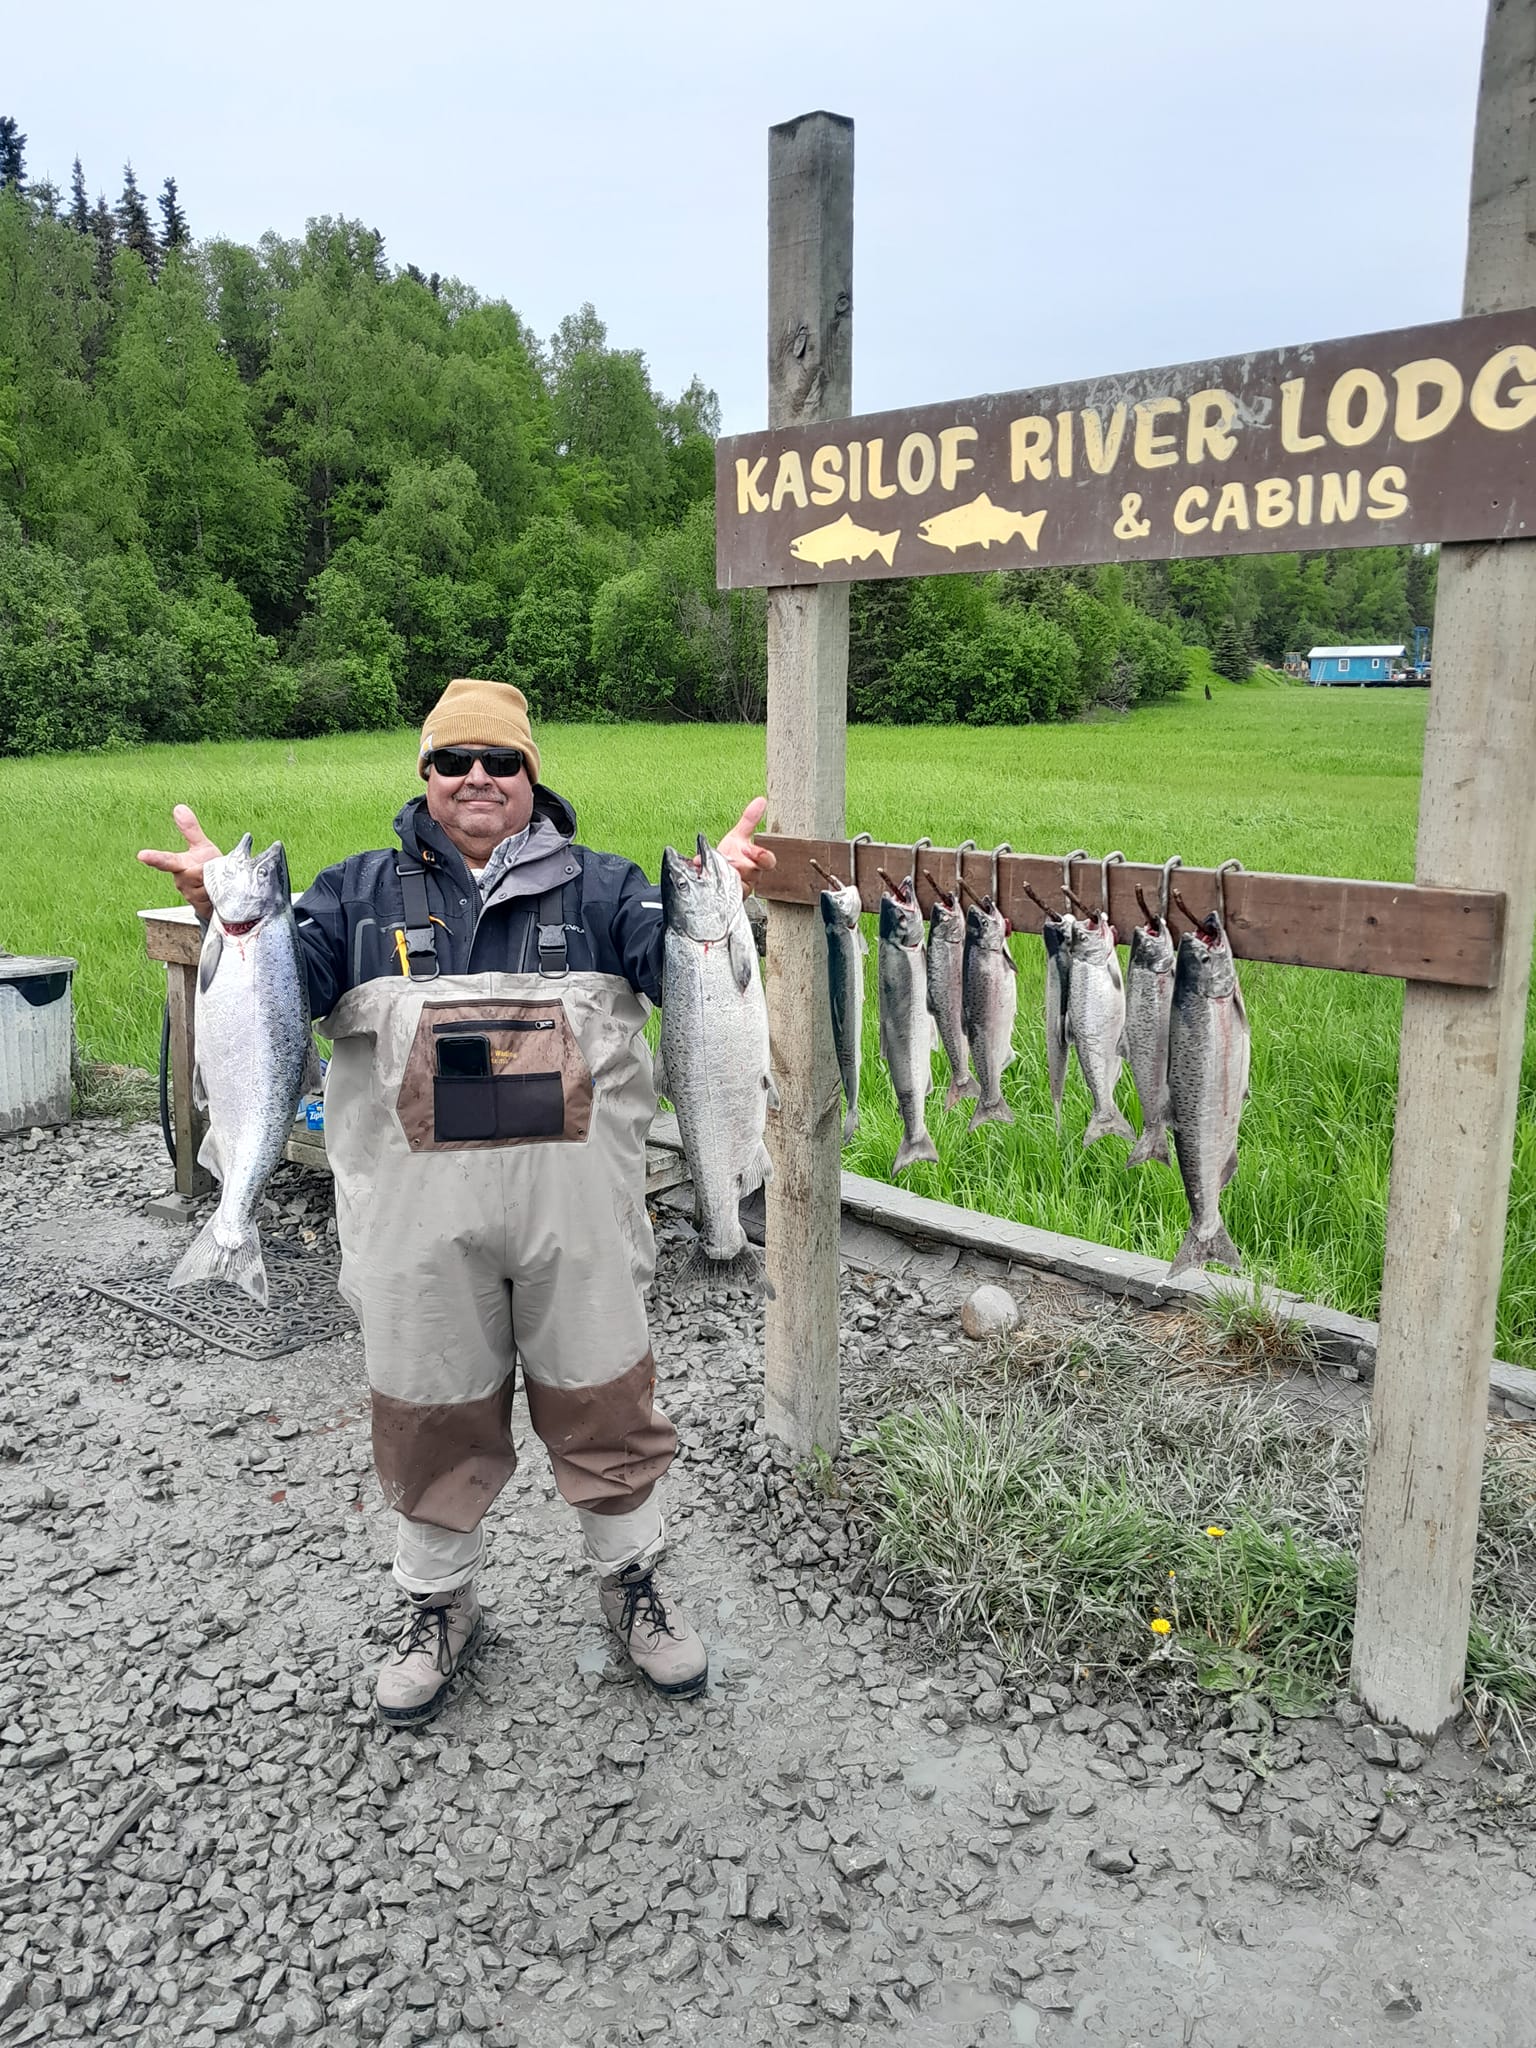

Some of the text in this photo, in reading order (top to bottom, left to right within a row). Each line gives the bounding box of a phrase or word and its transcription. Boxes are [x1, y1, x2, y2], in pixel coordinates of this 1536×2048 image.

[735, 426, 978, 514] KASILOF
[1010, 389, 1238, 483] RIVER
[1113, 466, 1408, 540] & CABINS
